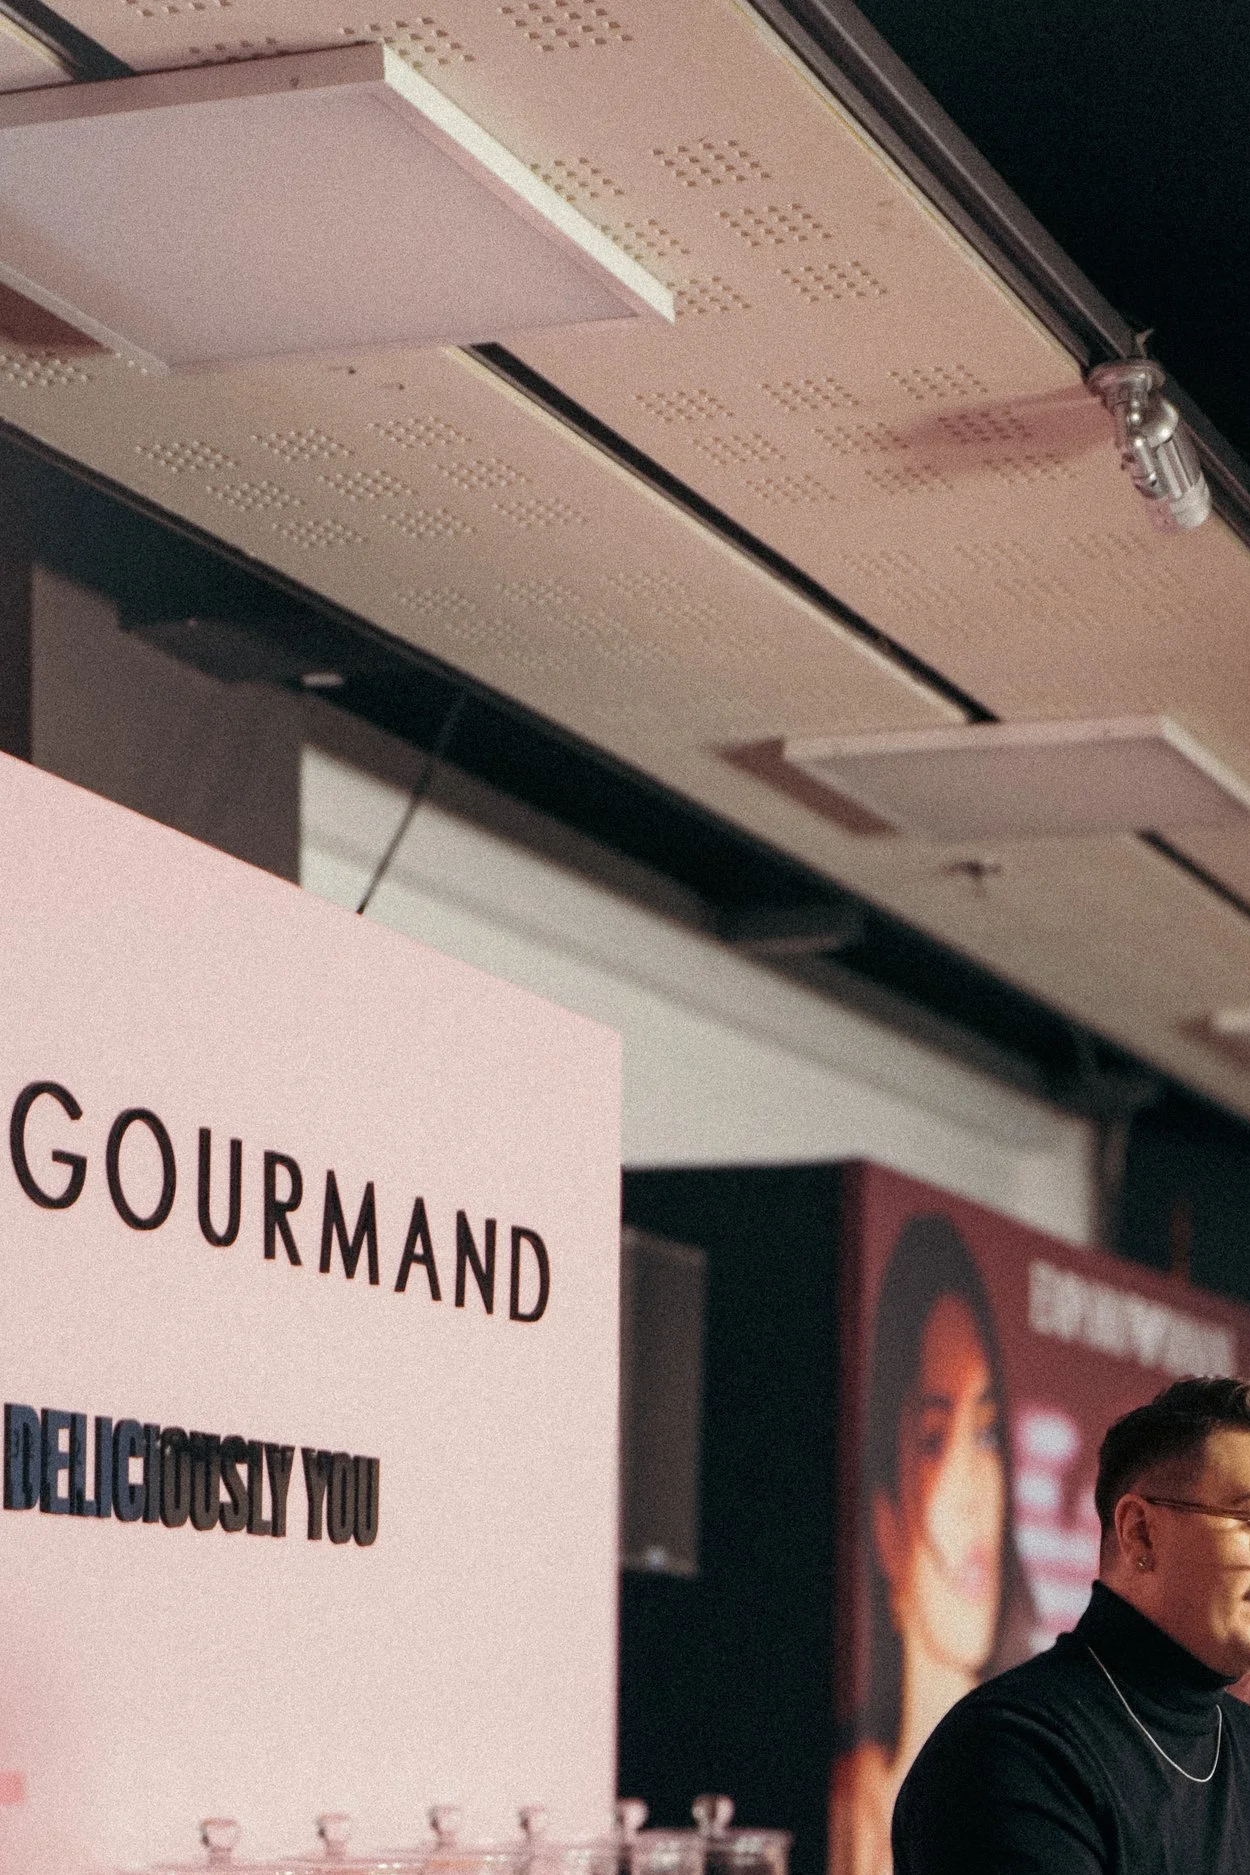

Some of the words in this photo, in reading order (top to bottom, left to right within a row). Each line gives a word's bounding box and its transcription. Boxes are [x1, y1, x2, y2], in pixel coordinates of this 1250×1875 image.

[9, 1079, 551, 1323] GOURMAND
[3, 1402, 296, 1538] DELICIOUSLY
[300, 1446, 381, 1548] YOU
